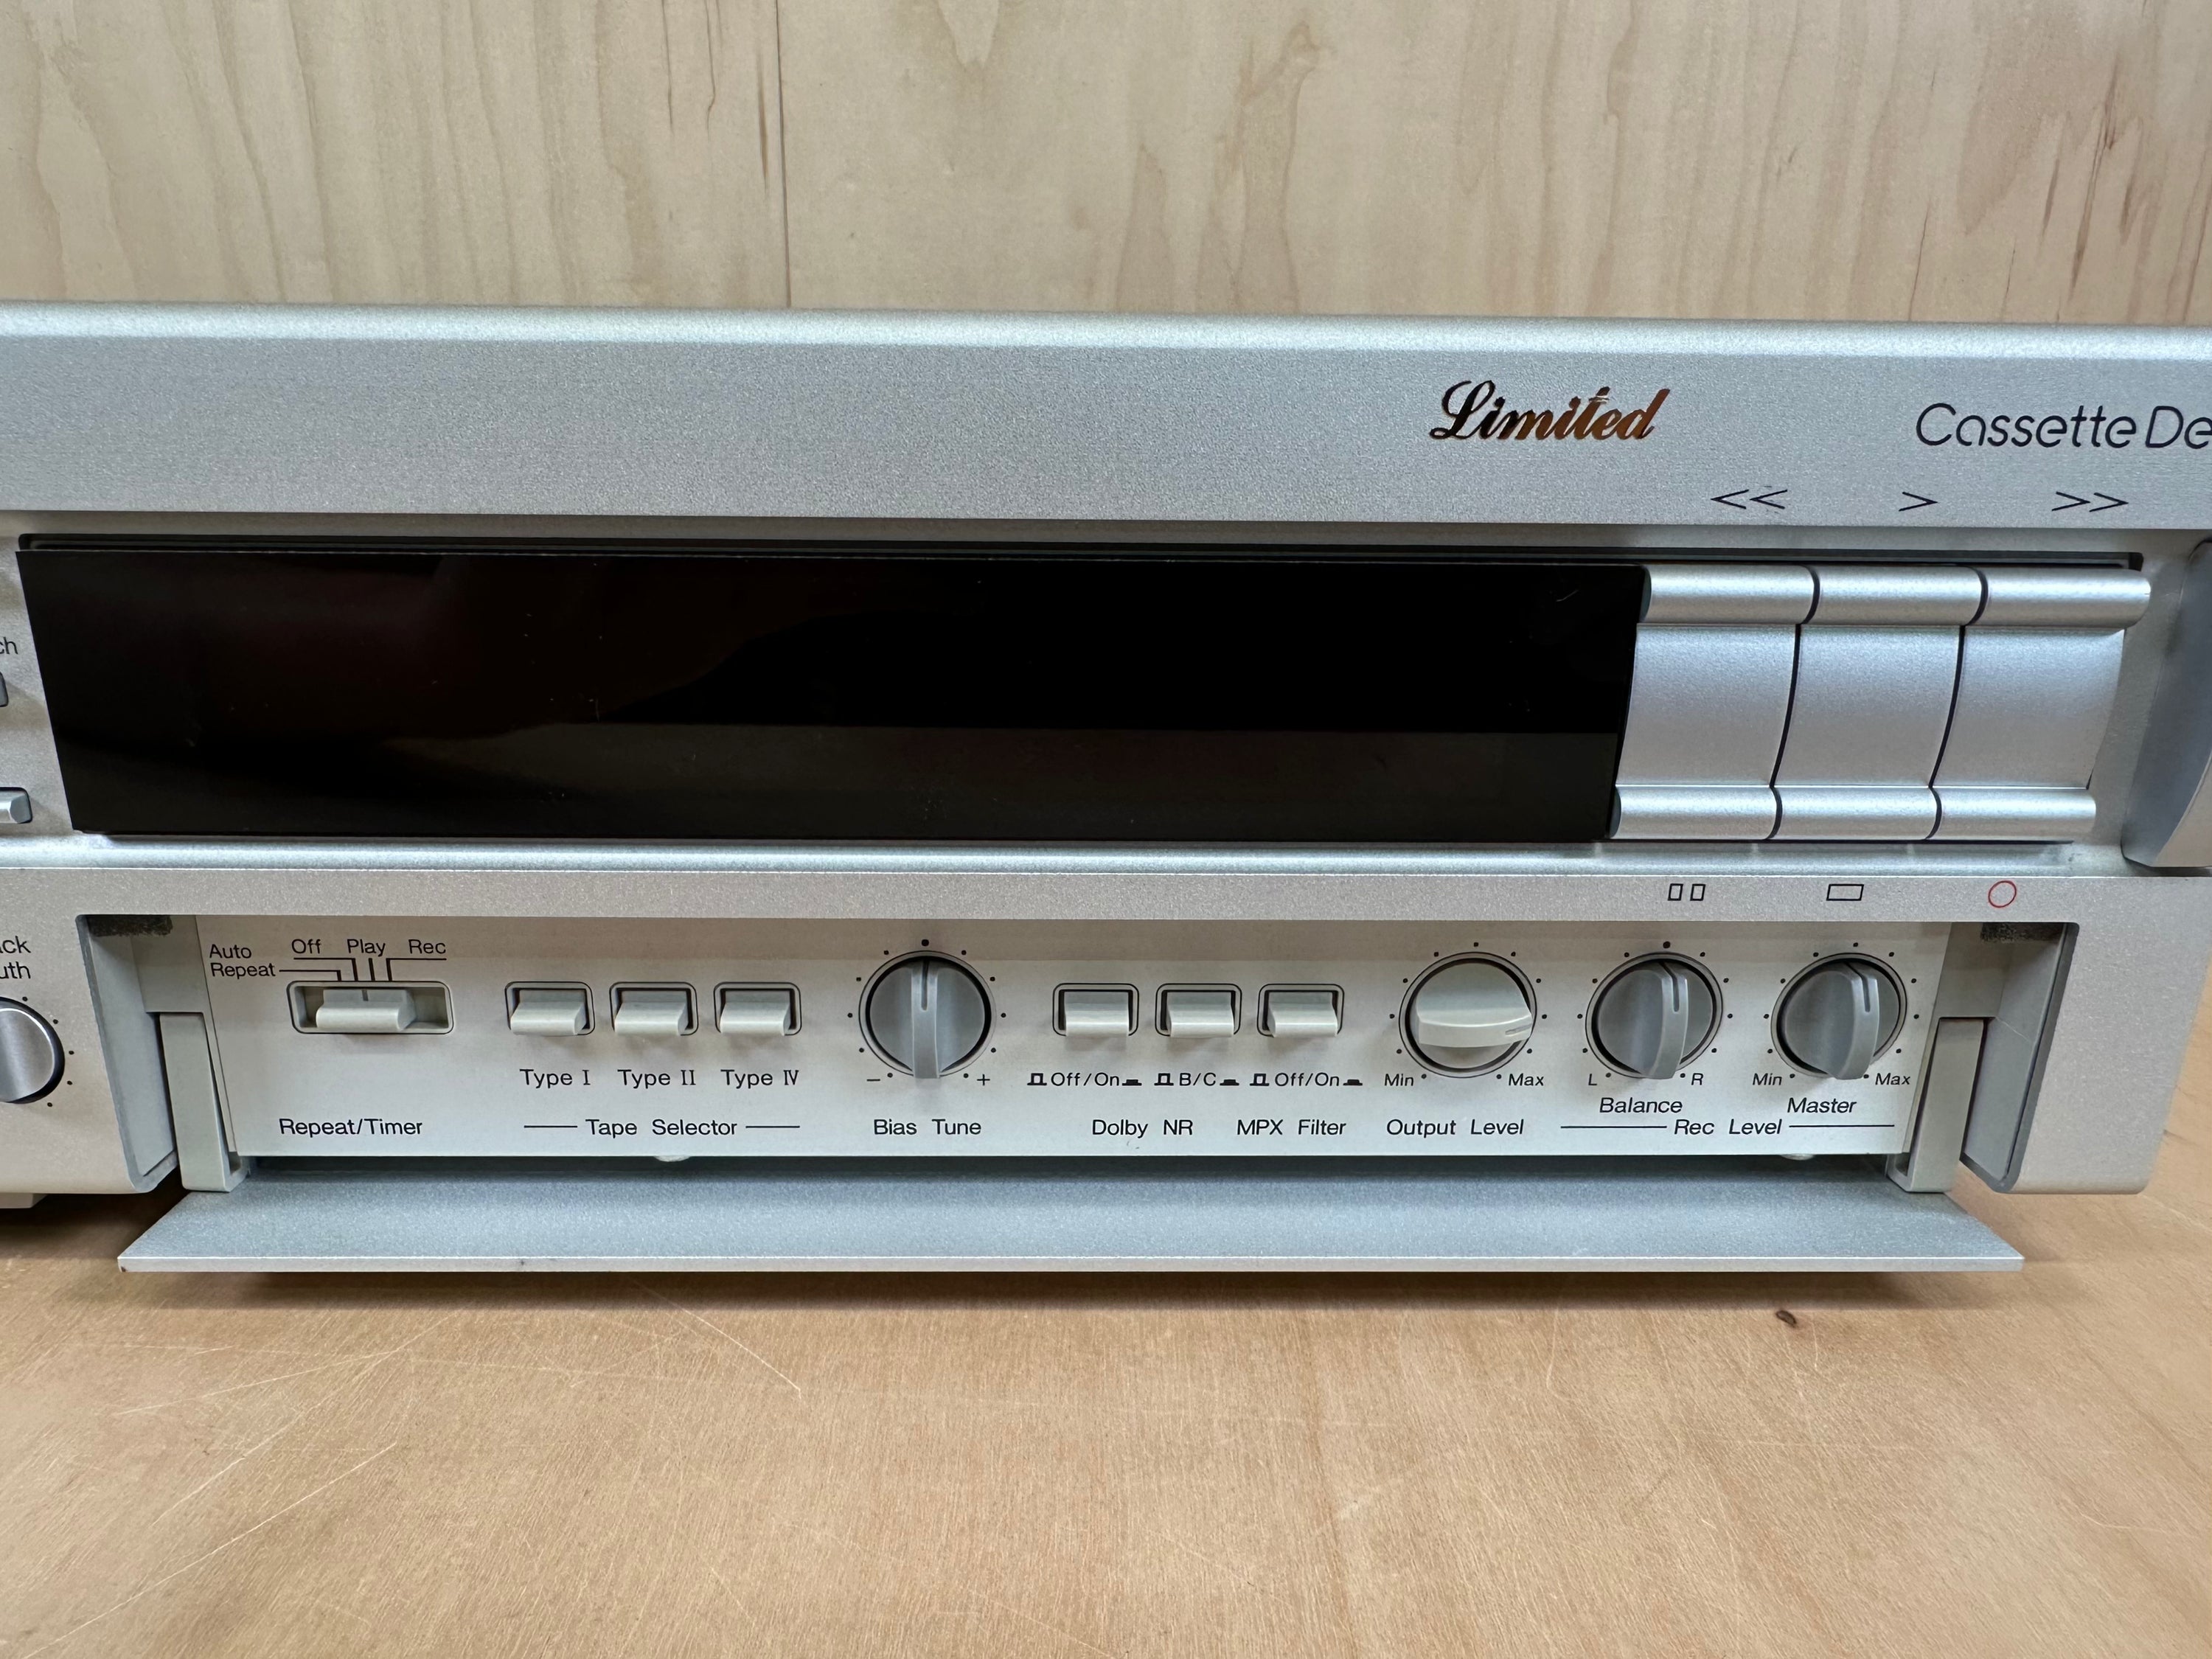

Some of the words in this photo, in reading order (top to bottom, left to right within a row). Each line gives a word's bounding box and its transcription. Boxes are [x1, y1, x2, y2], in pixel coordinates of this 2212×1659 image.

[1429, 380, 1671, 441] Limited
[1916, 402, 2137, 449] Cassette
[0, 935, 32, 954] ck
[209, 943, 252, 959] Auto
[291, 938, 321, 954] Off
[347, 938, 386, 958] Play
[408, 939, 446, 955] Rec
[209, 962, 276, 980] Repeat
[519, 1068, 573, 1089] Type
[616, 1068, 671, 1090] Type
[680, 1069, 697, 1086] II
[720, 1068, 773, 1090] Type
[783, 1069, 799, 1086] IV
[1051, 1071, 1120, 1087] Off/On
[1179, 1072, 1217, 1087] B/C
[1274, 1071, 1340, 1087] Off/On
[1384, 1073, 1414, 1087] Min
[1508, 1073, 1544, 1086] Max
[1587, 1073, 1598, 1086] L
[1691, 1072, 1704, 1086] R
[1752, 1073, 1783, 1086] Min
[1875, 1072, 1911, 1085] Max
[1599, 1096, 1683, 1113] Balance
[1787, 1096, 1857, 1113] Master
[279, 1118, 423, 1138] Repeat/Timer
[585, 1119, 638, 1139] Tape
[652, 1119, 738, 1135] Selector
[874, 1118, 917, 1135] Bias
[931, 1119, 981, 1135] Tune
[1092, 1119, 1149, 1139] Dolby
[1163, 1119, 1194, 1135] NR
[1237, 1119, 1284, 1135] MPX
[1298, 1119, 1347, 1135] Filter
[1386, 1119, 1457, 1138] Output
[1470, 1119, 1524, 1135] Level
[1674, 1119, 1715, 1135] Rec
[1728, 1118, 1783, 1135] Level
